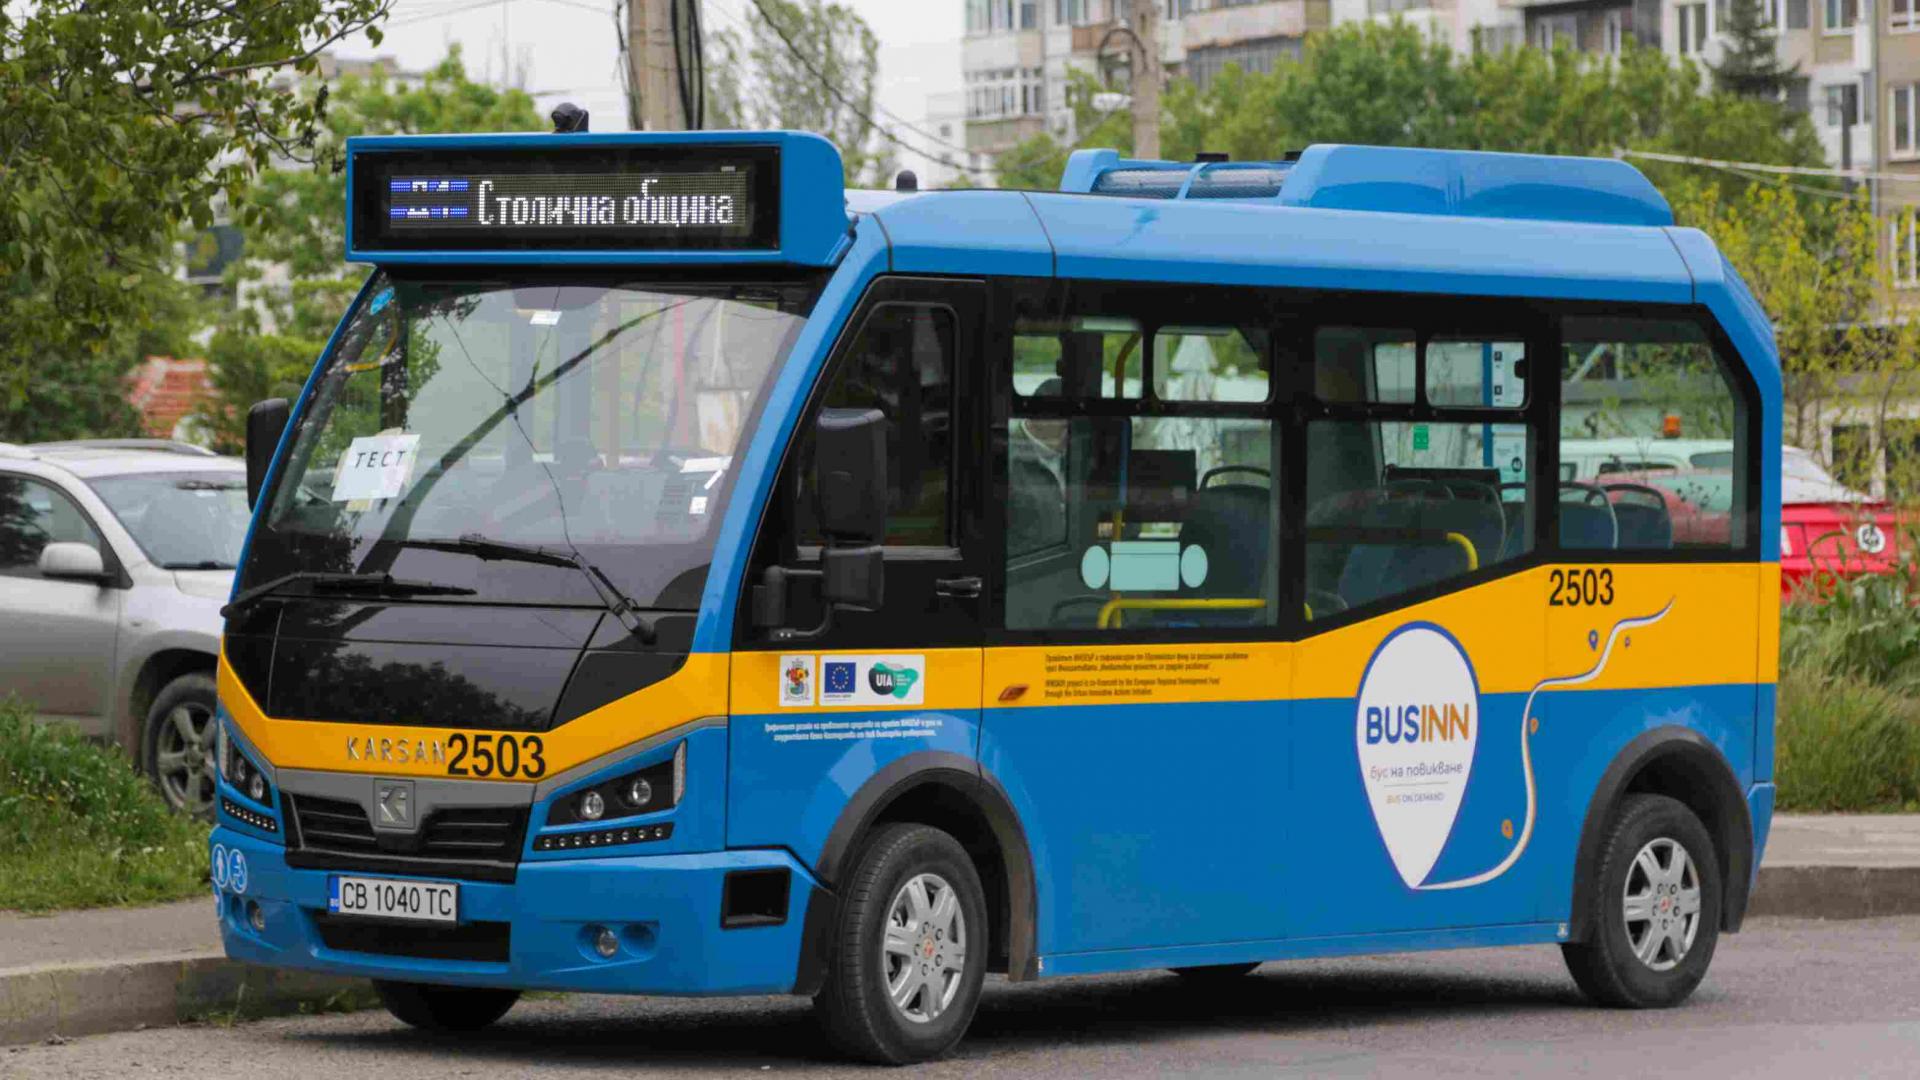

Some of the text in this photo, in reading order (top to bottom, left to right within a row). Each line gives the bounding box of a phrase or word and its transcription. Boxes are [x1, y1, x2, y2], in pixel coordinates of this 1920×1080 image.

[478, 180, 615, 225] Столична
[623, 178, 733, 227] община
[1549, 568, 1614, 606] 2503
[876, 673, 893, 687] UIA
[1366, 703, 1469, 745] BUSINN
[346, 736, 446, 765] KARSAN
[447, 733, 546, 778] 2503
[1370, 761, 1463, 781] бус на повикване
[375, 885, 421, 913] 1040
